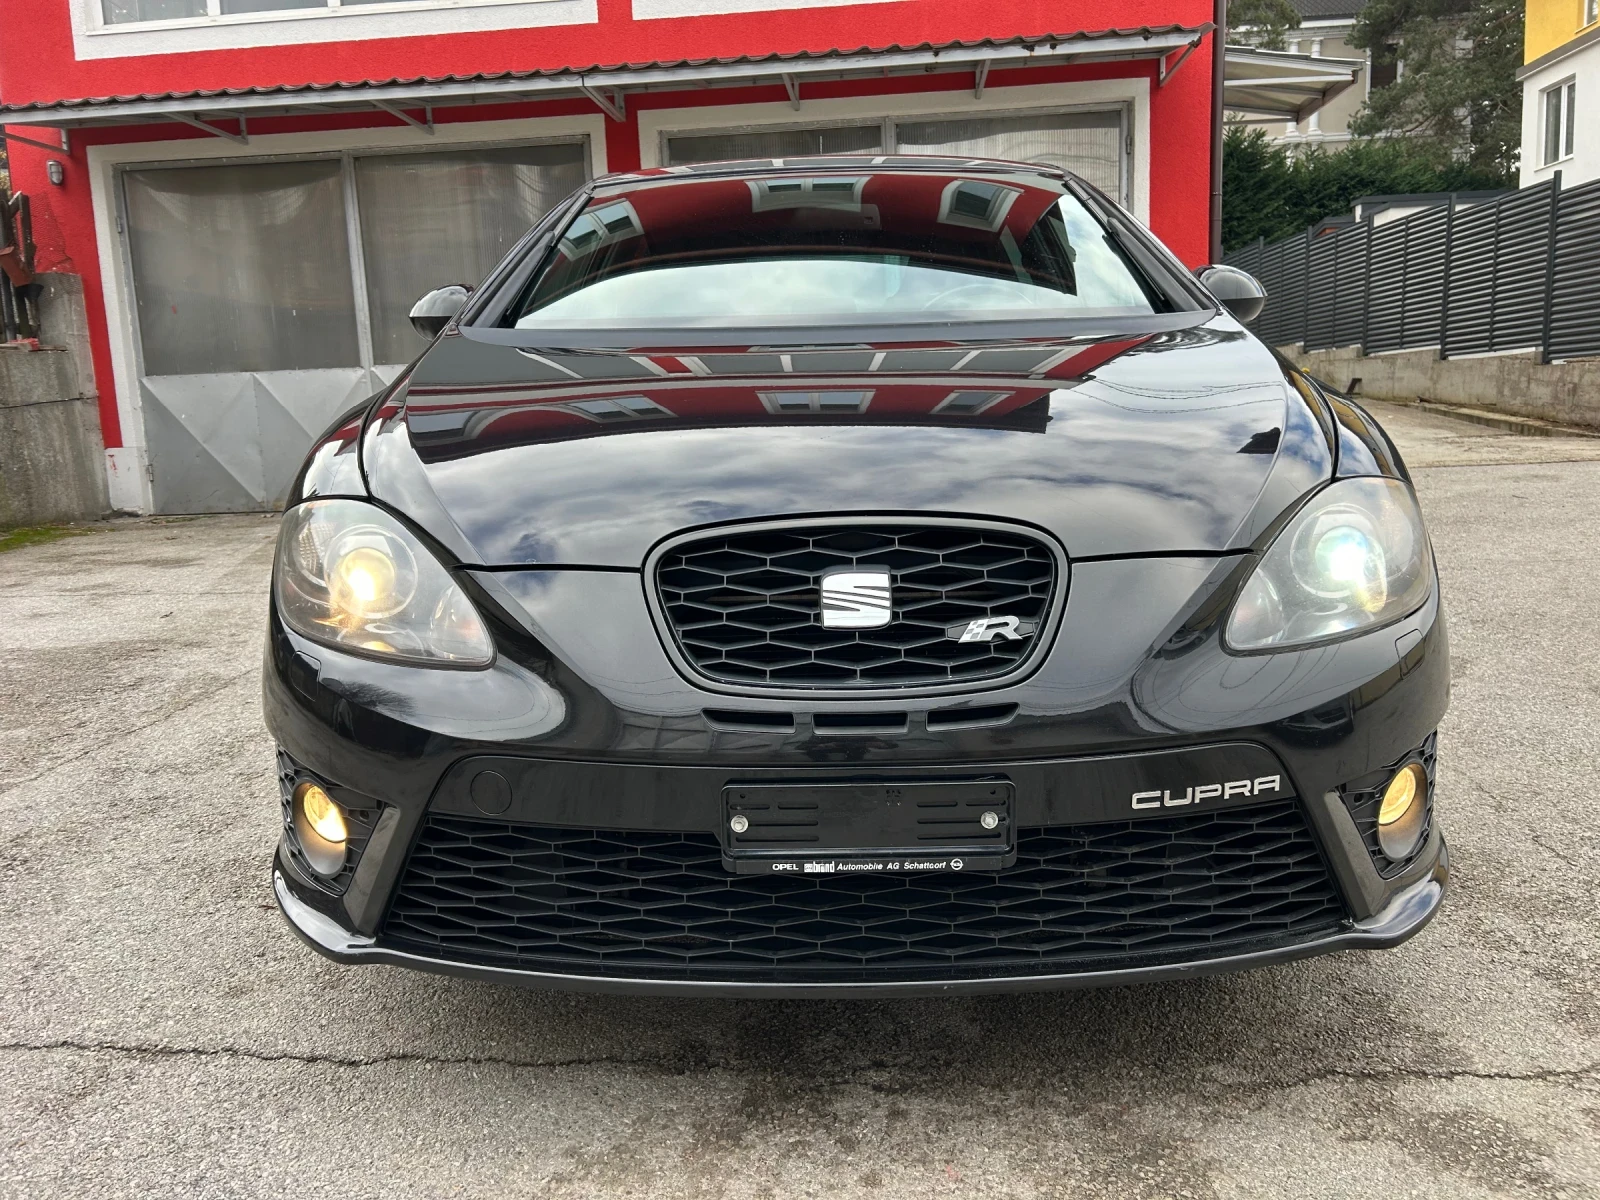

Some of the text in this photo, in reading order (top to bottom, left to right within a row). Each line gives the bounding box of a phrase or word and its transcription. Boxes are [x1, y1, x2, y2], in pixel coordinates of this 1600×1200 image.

[1131, 775, 1281, 810] CUPRA
[772, 863, 799, 871] OPEL
[836, 861, 883, 871] Automobile
[886, 862, 900, 870] AG
